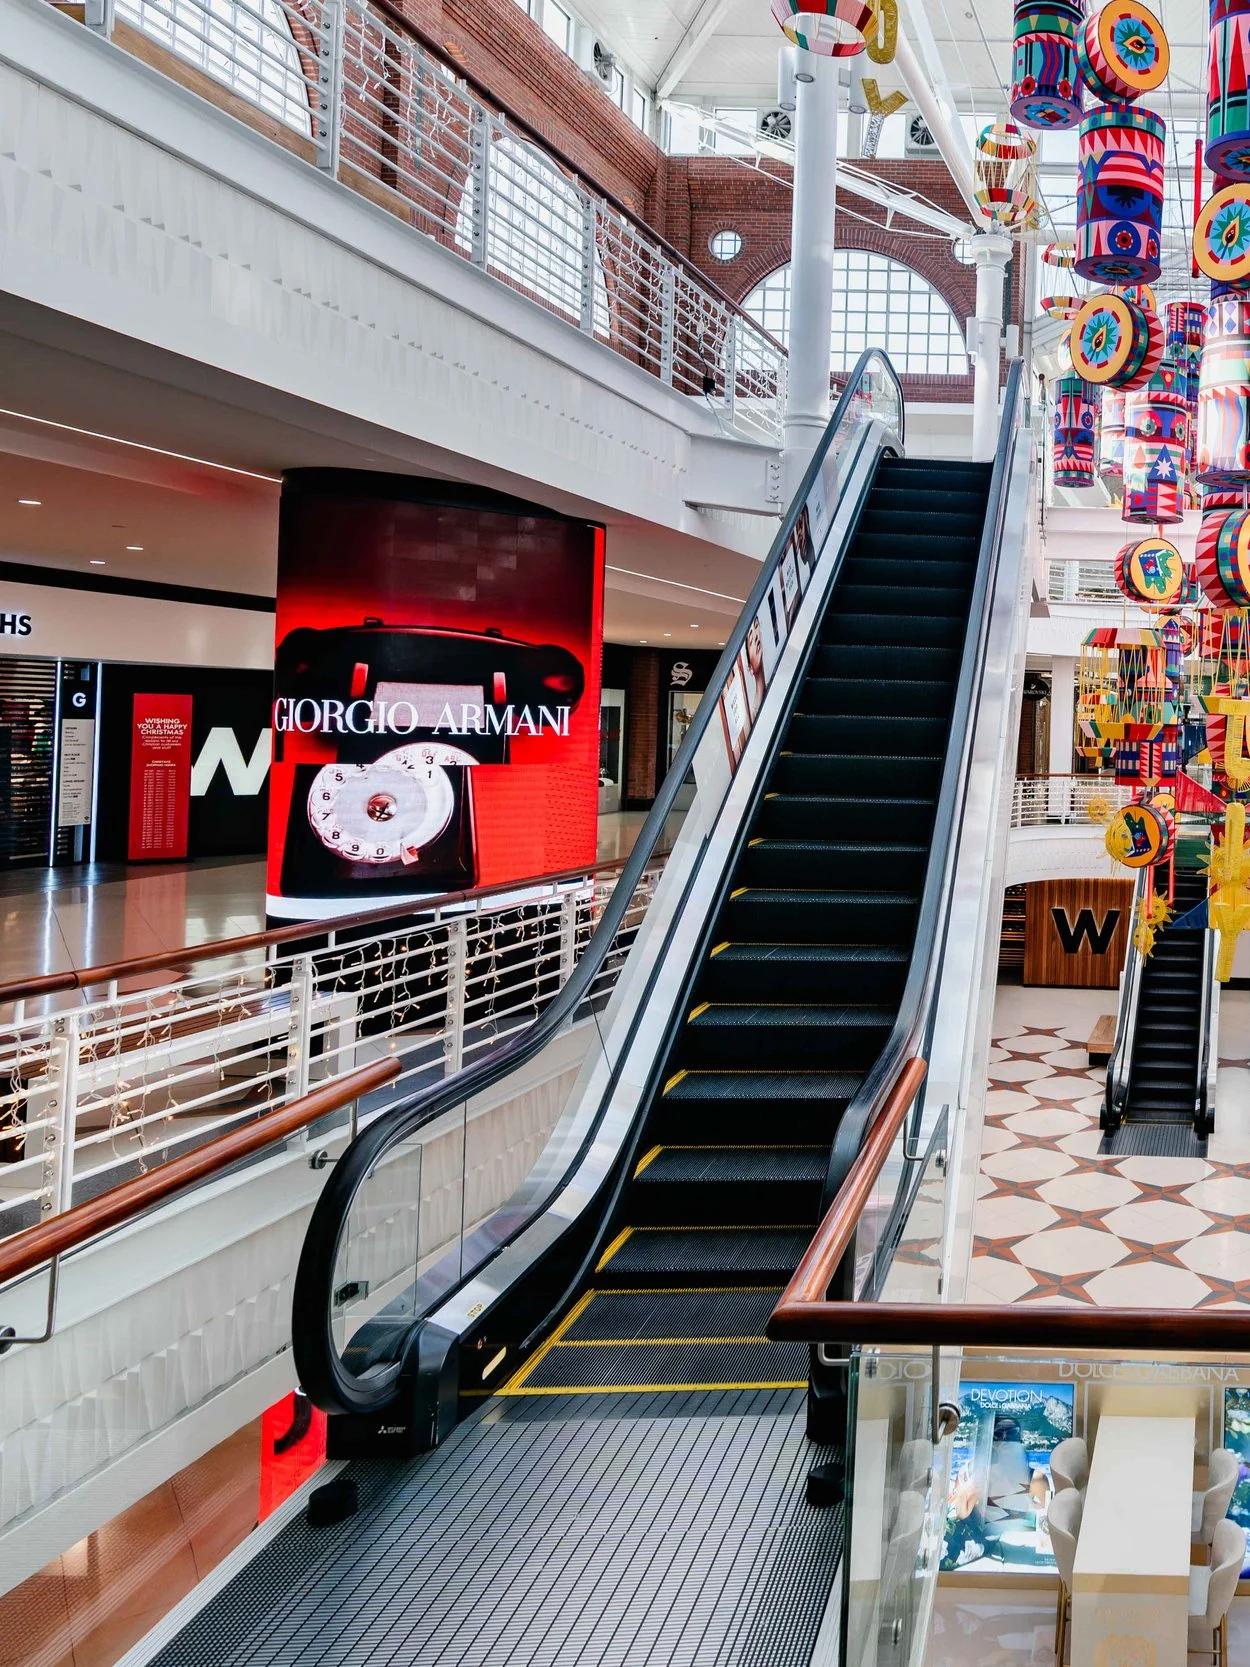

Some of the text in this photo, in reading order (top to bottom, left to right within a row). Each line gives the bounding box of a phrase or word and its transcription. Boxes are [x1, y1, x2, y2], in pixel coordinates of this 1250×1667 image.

[72, 692, 87, 708] G
[274, 697, 571, 737] GIORGIO ARMANI
[425, 756, 434, 765] 3
[335, 773, 343, 781] 5
[427, 770, 432, 778] 1
[322, 792, 331, 801] 6
[322, 812, 331, 821] 7
[332, 831, 340, 840] 8
[351, 844, 360, 852] 9
[376, 847, 385, 856] 0
[1051, 907, 1121, 955] W
[467, 1303, 484, 1318] STOP
[970, 1388, 1043, 1403] DEVOTION
